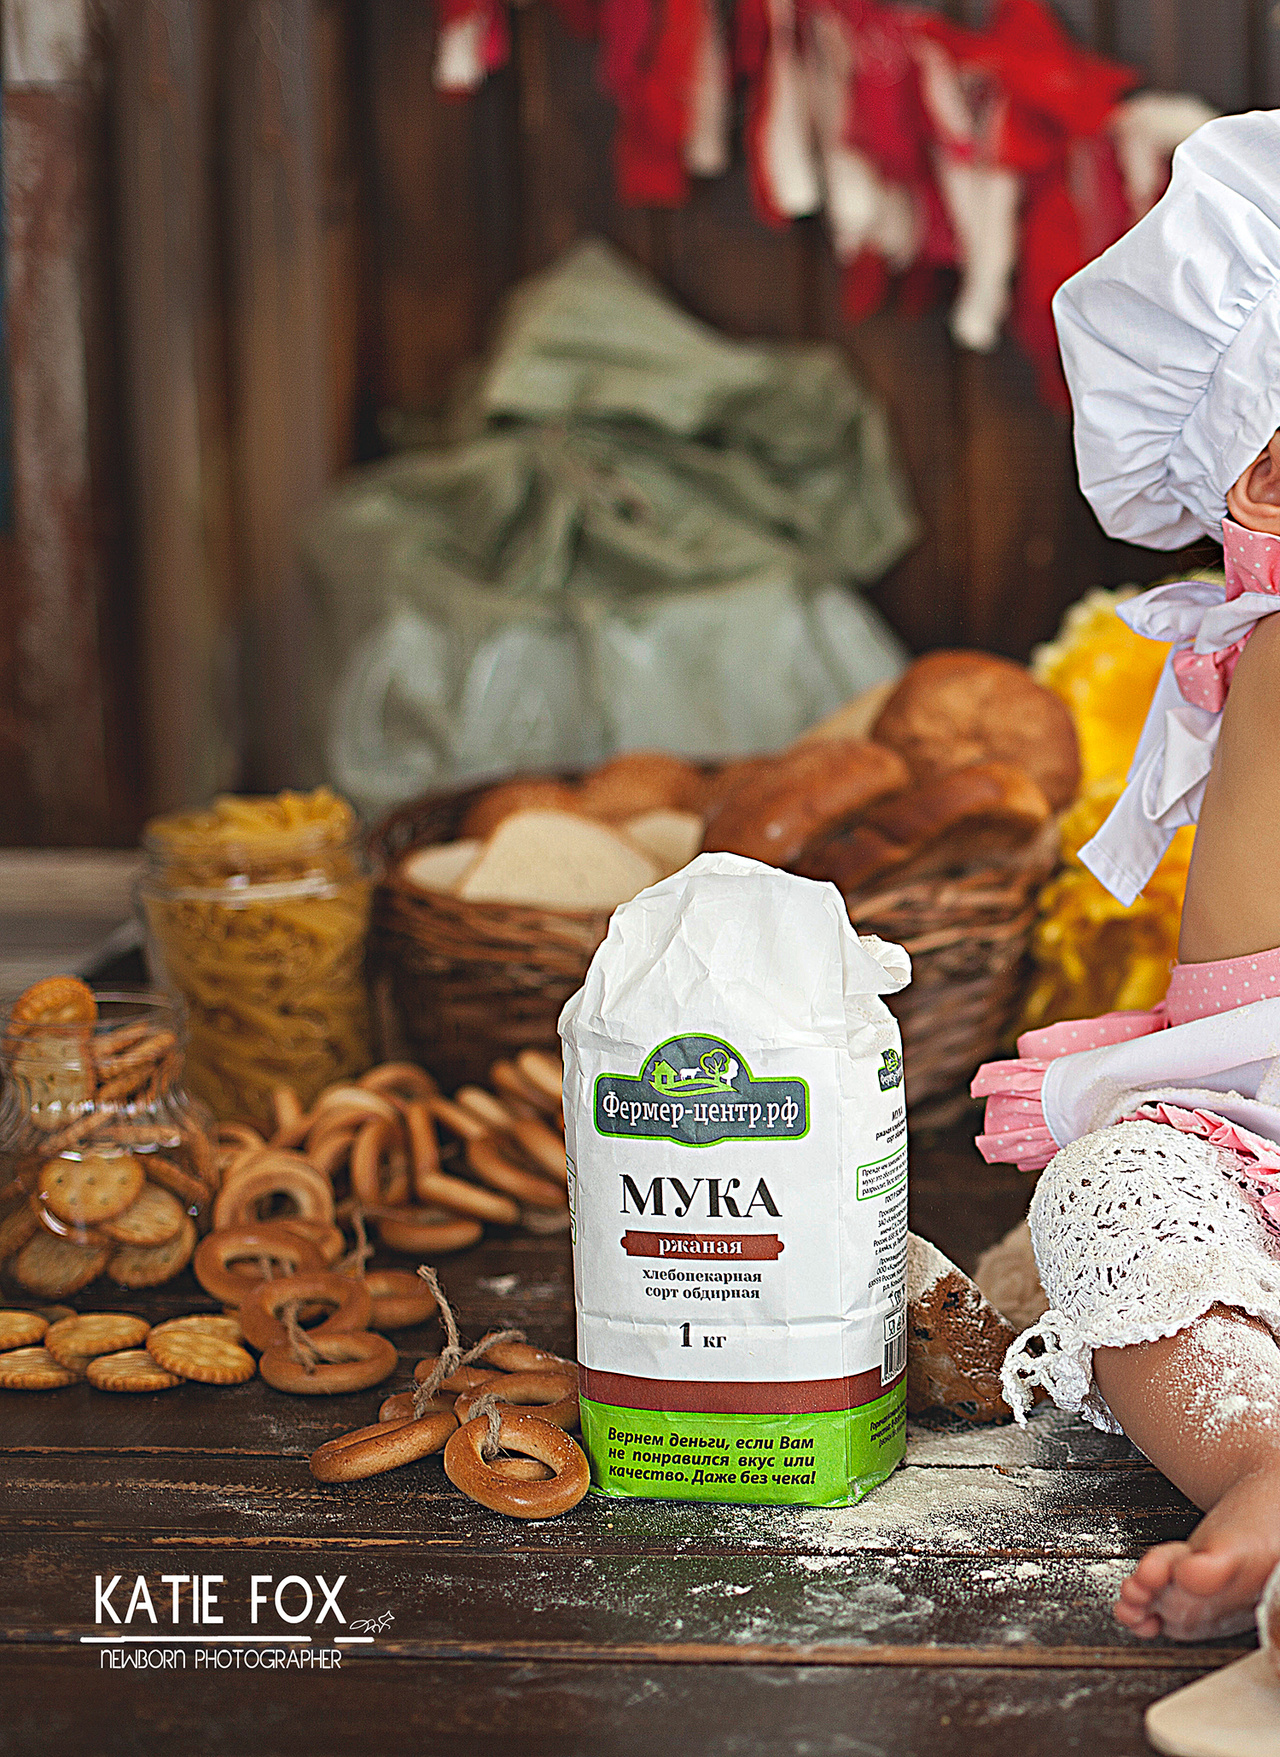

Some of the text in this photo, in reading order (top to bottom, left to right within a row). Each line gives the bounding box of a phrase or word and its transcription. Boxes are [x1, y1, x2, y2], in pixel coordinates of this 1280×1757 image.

[602, 1091, 799, 1129] Фермер-центр.рф
[619, 1173, 783, 1219] МУКА
[658, 1236, 743, 1255] ржаная
[642, 1268, 763, 1283] хлебопекарная
[645, 1287, 760, 1302] сорт обдирная
[678, 1322, 727, 1348] 1 кг
[607, 1427, 814, 1451] Вернем деньги, если Вам
[608, 1447, 815, 1469] не понравился вкус или
[608, 1463, 817, 1486] качество. Даже без чека!
